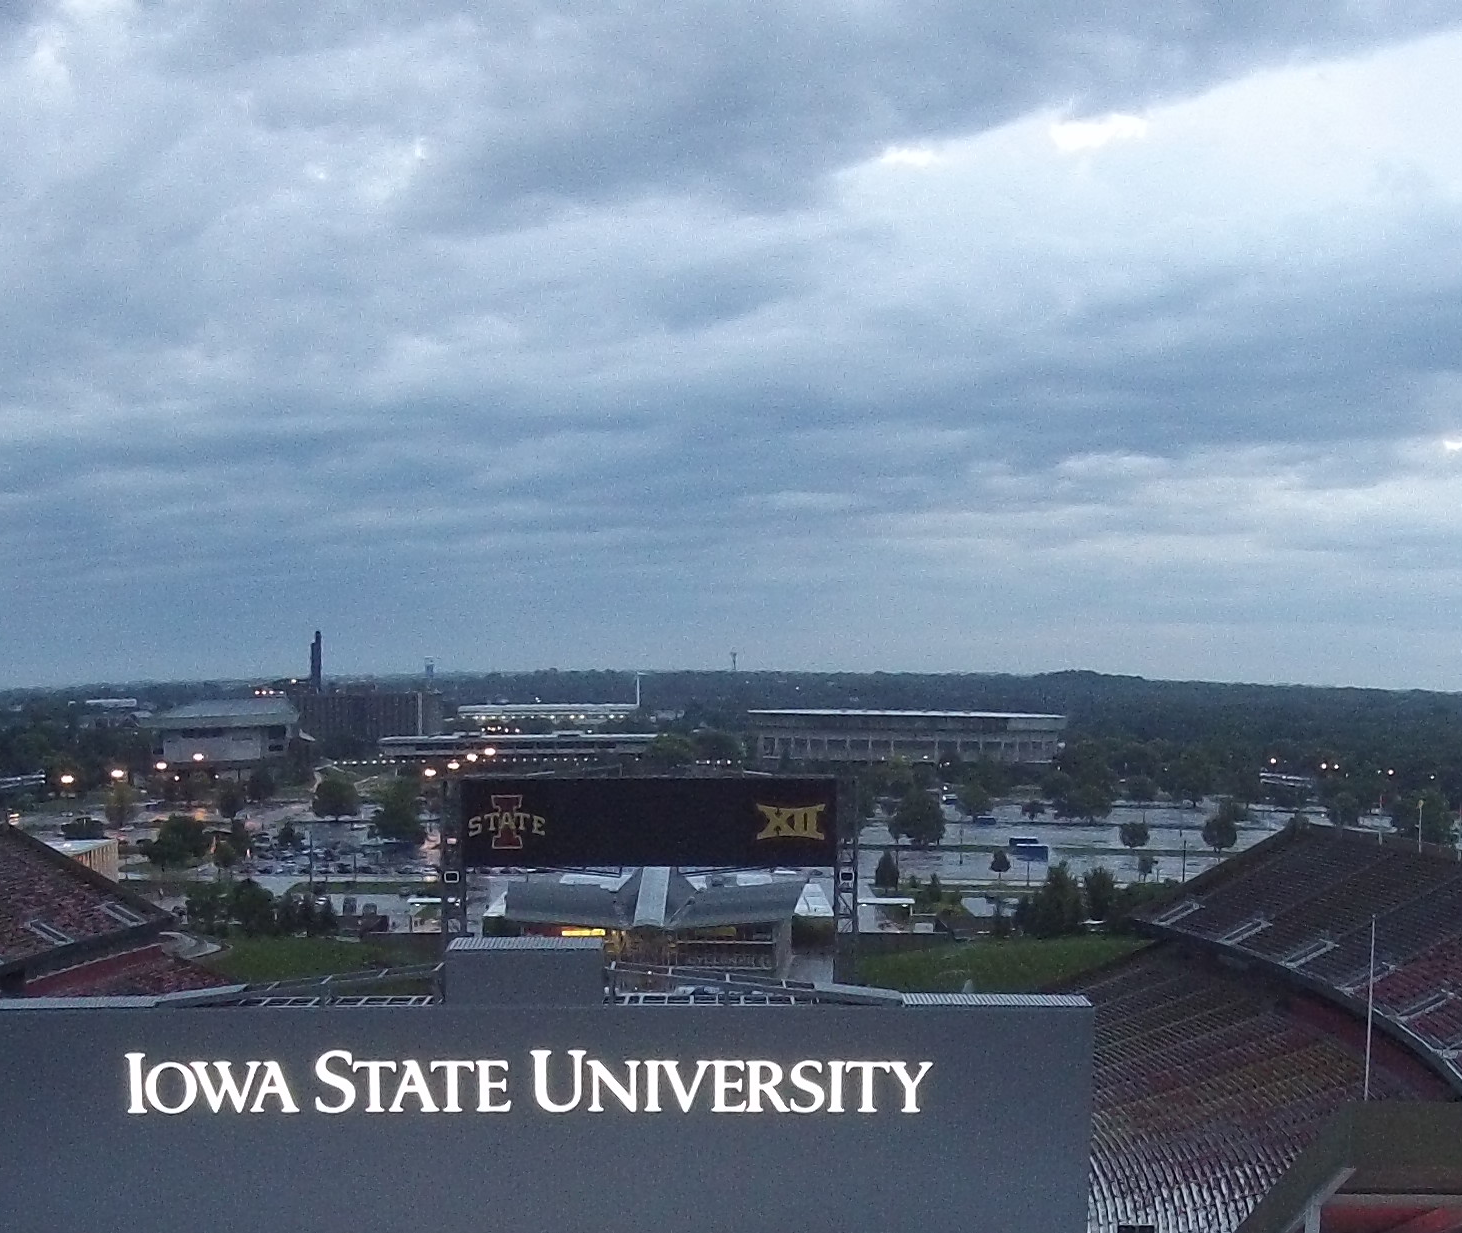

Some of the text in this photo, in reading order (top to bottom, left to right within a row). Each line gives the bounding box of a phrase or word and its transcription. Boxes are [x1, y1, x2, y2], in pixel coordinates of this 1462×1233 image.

[468, 811, 546, 838] STATE
[756, 803, 826, 841] XII
[125, 1049, 933, 1114] IOWA STATE UNIVERSITY
